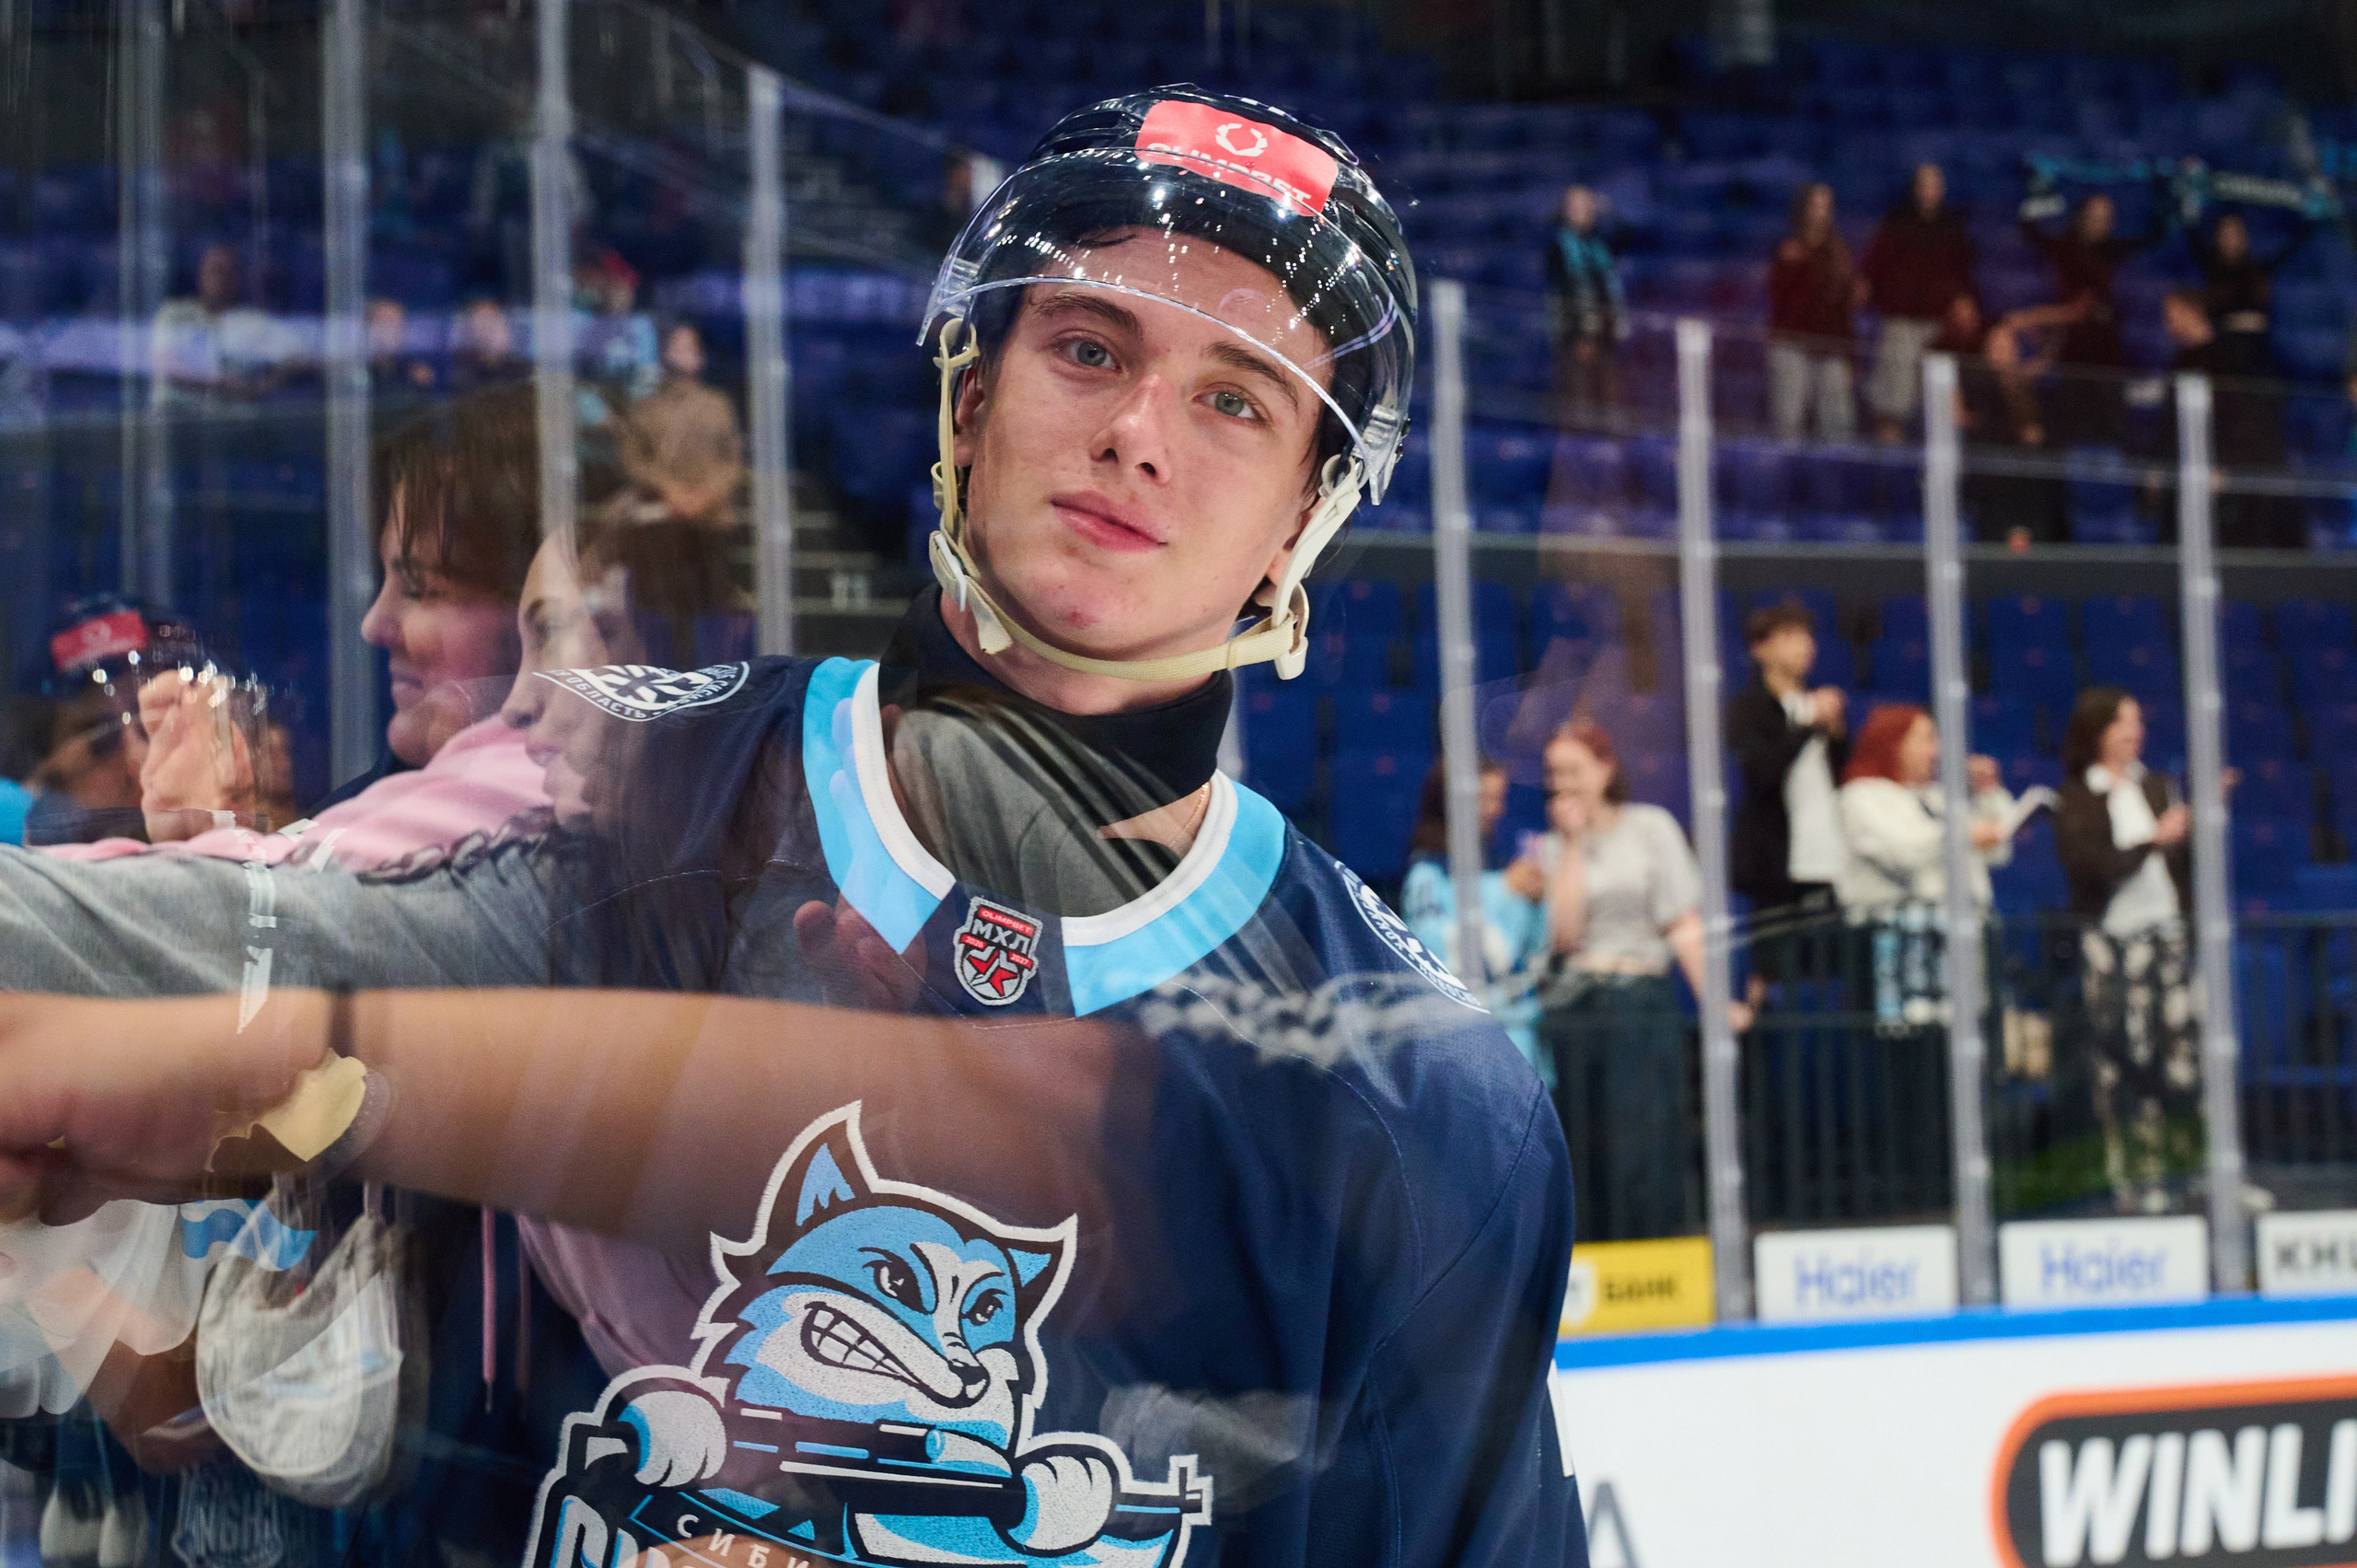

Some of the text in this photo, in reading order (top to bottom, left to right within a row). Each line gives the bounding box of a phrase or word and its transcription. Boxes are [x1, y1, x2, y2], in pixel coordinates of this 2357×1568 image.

[565, 677, 647, 718] ОБЛАСТЬ
[971, 918, 1030, 955] МХЛ
[981, 910, 1032, 933] OLIMPBET
[1794, 1247, 1918, 1306] Haier
[2039, 1238, 2167, 1295] Haier
